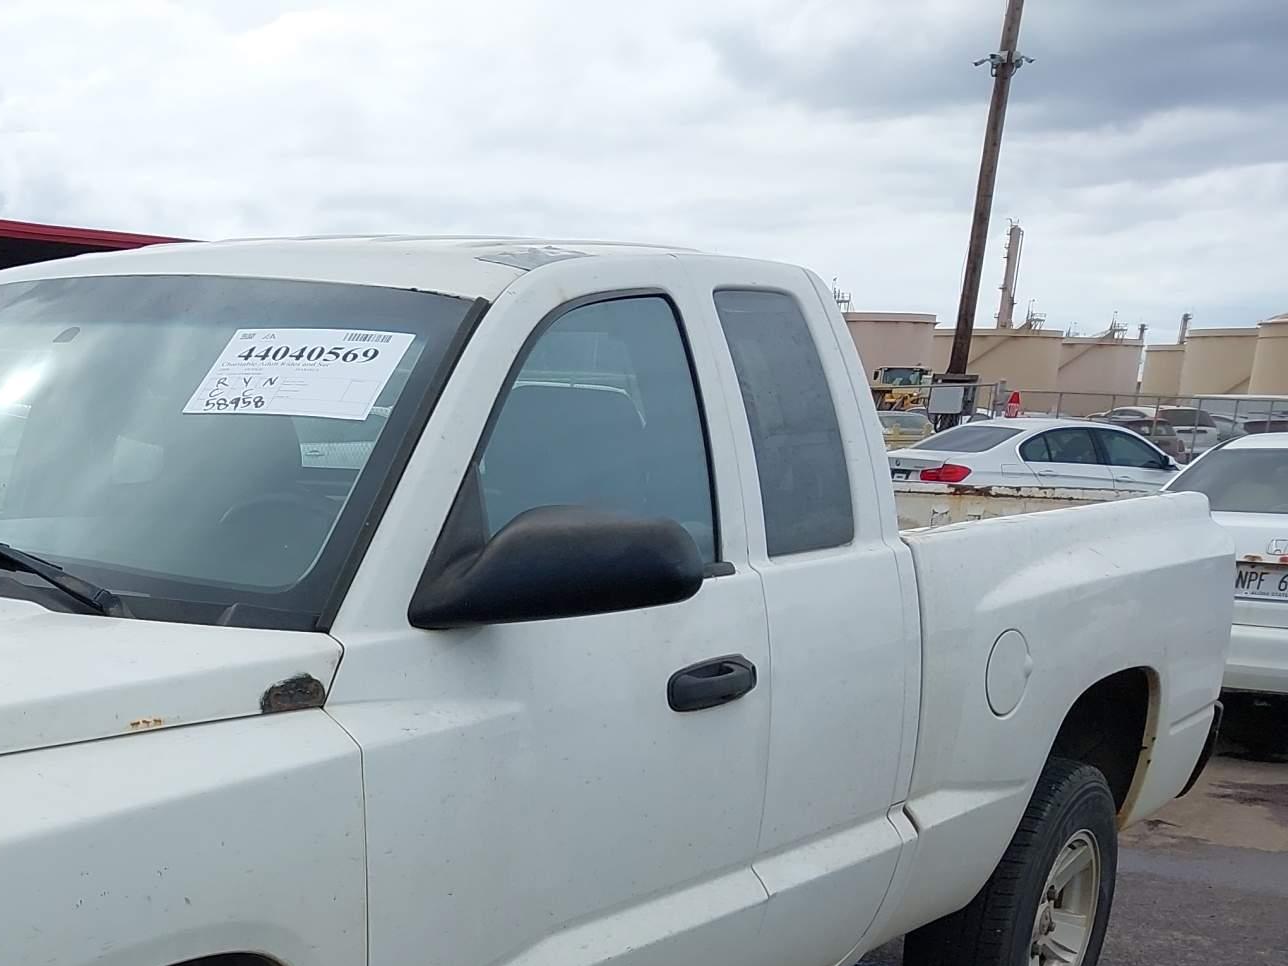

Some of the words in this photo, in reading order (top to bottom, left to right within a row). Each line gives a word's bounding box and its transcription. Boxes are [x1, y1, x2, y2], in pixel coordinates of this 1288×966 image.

[237, 345, 379, 363] 44040569
[216, 377, 229, 387] R
[243, 376, 252, 387] Y
[1235, 570, 1270, 590] NPF
